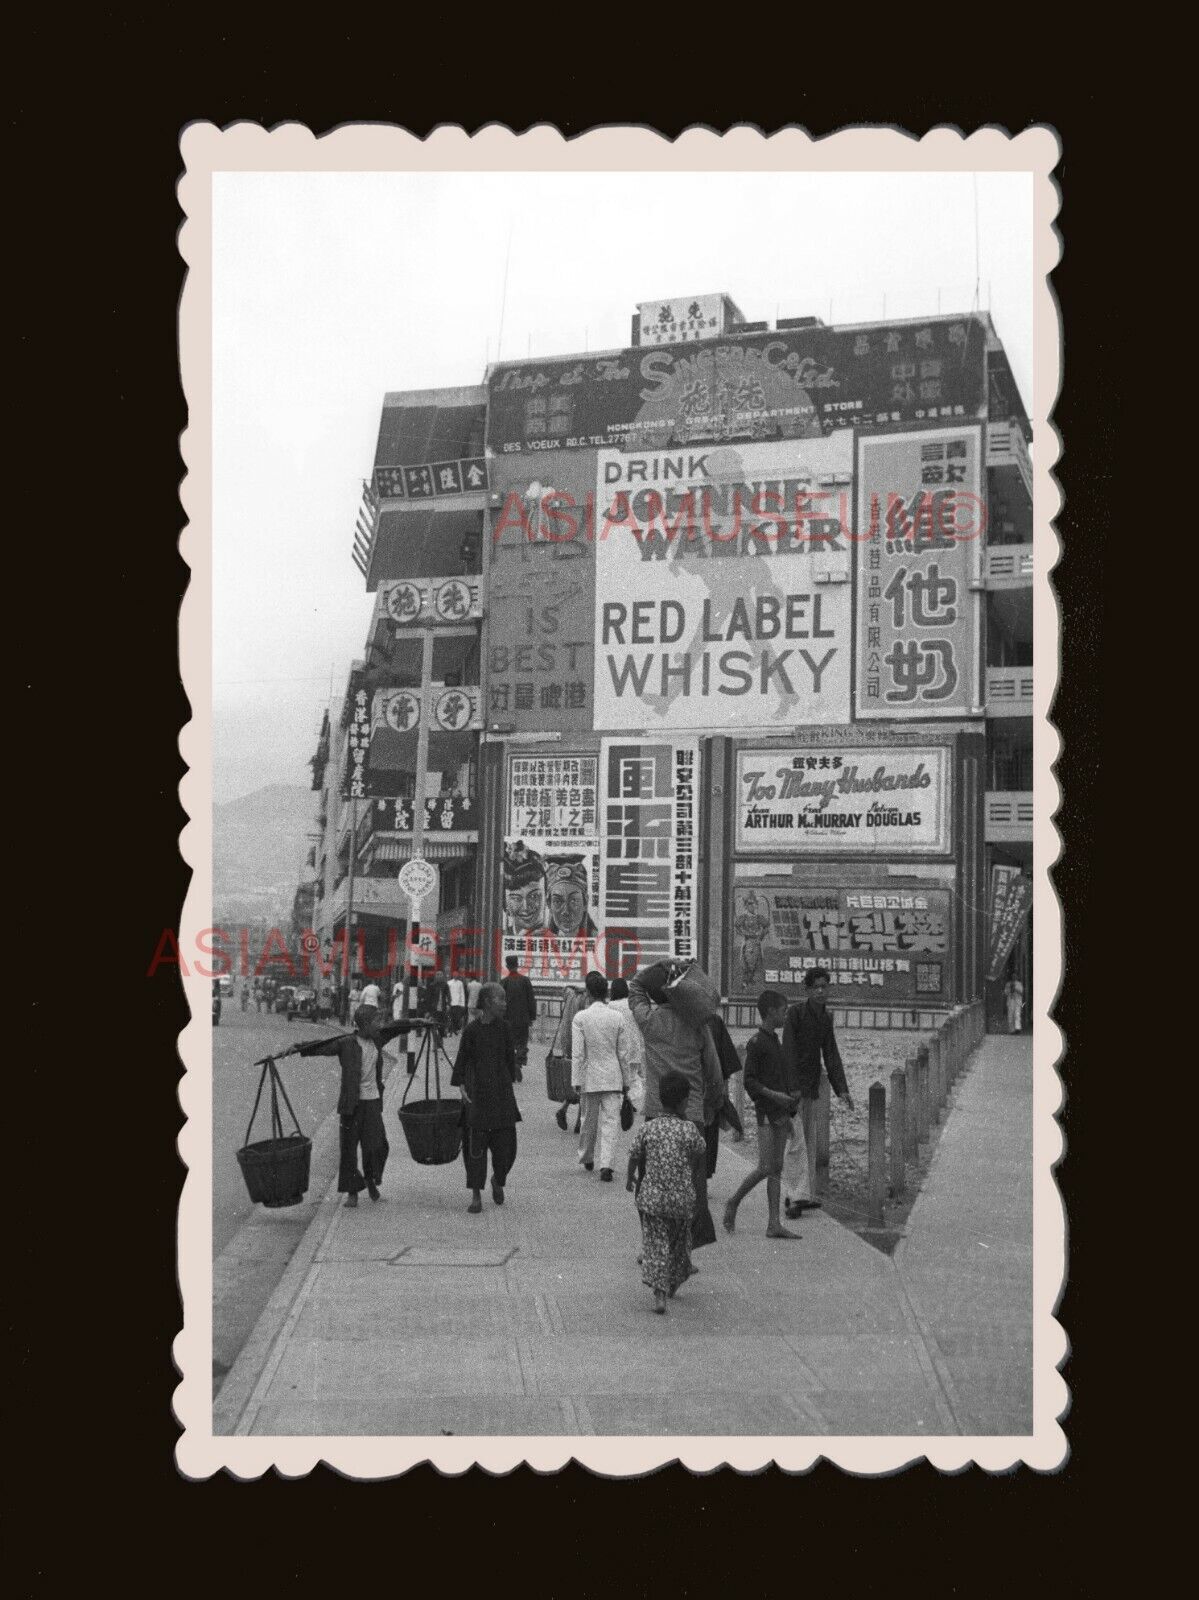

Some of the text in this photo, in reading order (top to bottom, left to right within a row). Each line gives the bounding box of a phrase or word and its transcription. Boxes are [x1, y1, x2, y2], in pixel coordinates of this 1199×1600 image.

[823, 401, 863, 413] STORE
[603, 454, 710, 484] DRINK
[602, 478, 812, 523] JOHNNIE
[631, 518, 848, 562] WALKER
[885, 489, 958, 702] 維他奶
[525, 604, 559, 635] IS
[602, 594, 835, 645] RED LABEL
[489, 640, 592, 673] BEST
[606, 648, 838, 698] WHISKY
[742, 763, 931, 809] Too Many Husbands
[744, 813, 793, 829] ARTHUR
[866, 812, 921, 828] DOUGLAS
